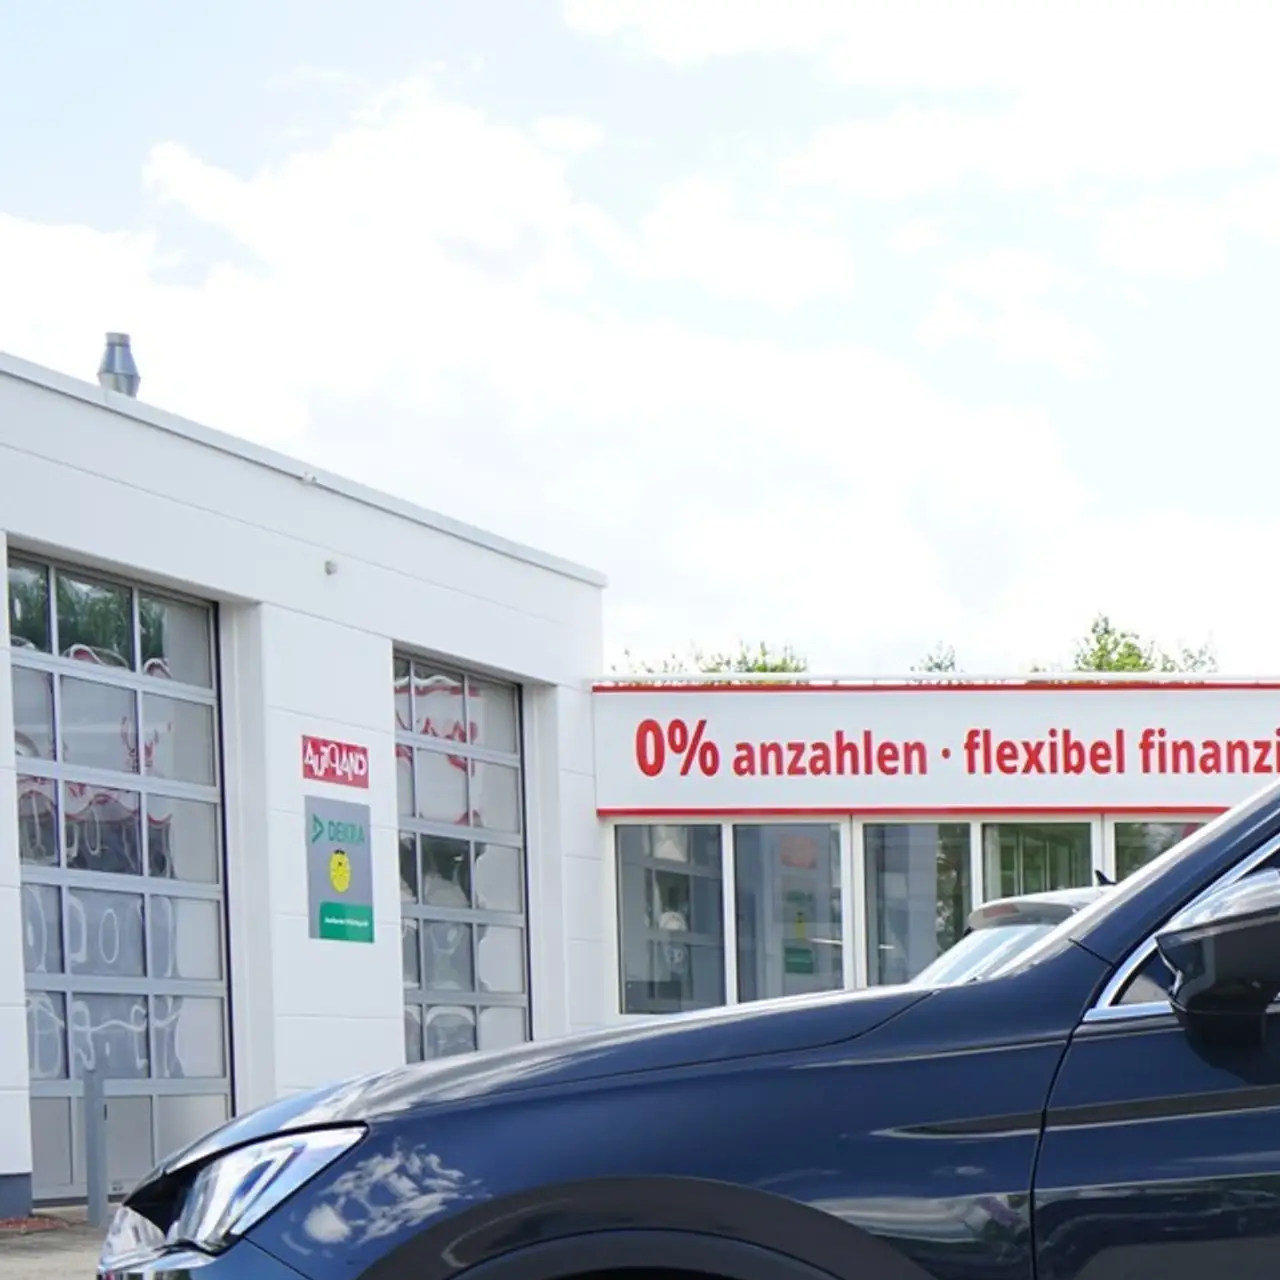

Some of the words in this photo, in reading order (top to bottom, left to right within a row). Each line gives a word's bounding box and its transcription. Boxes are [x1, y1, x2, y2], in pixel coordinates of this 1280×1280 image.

[635, 718, 720, 777] 0%
[733, 729, 927, 777] anzahlen
[964, 729, 1126, 775] flexibel
